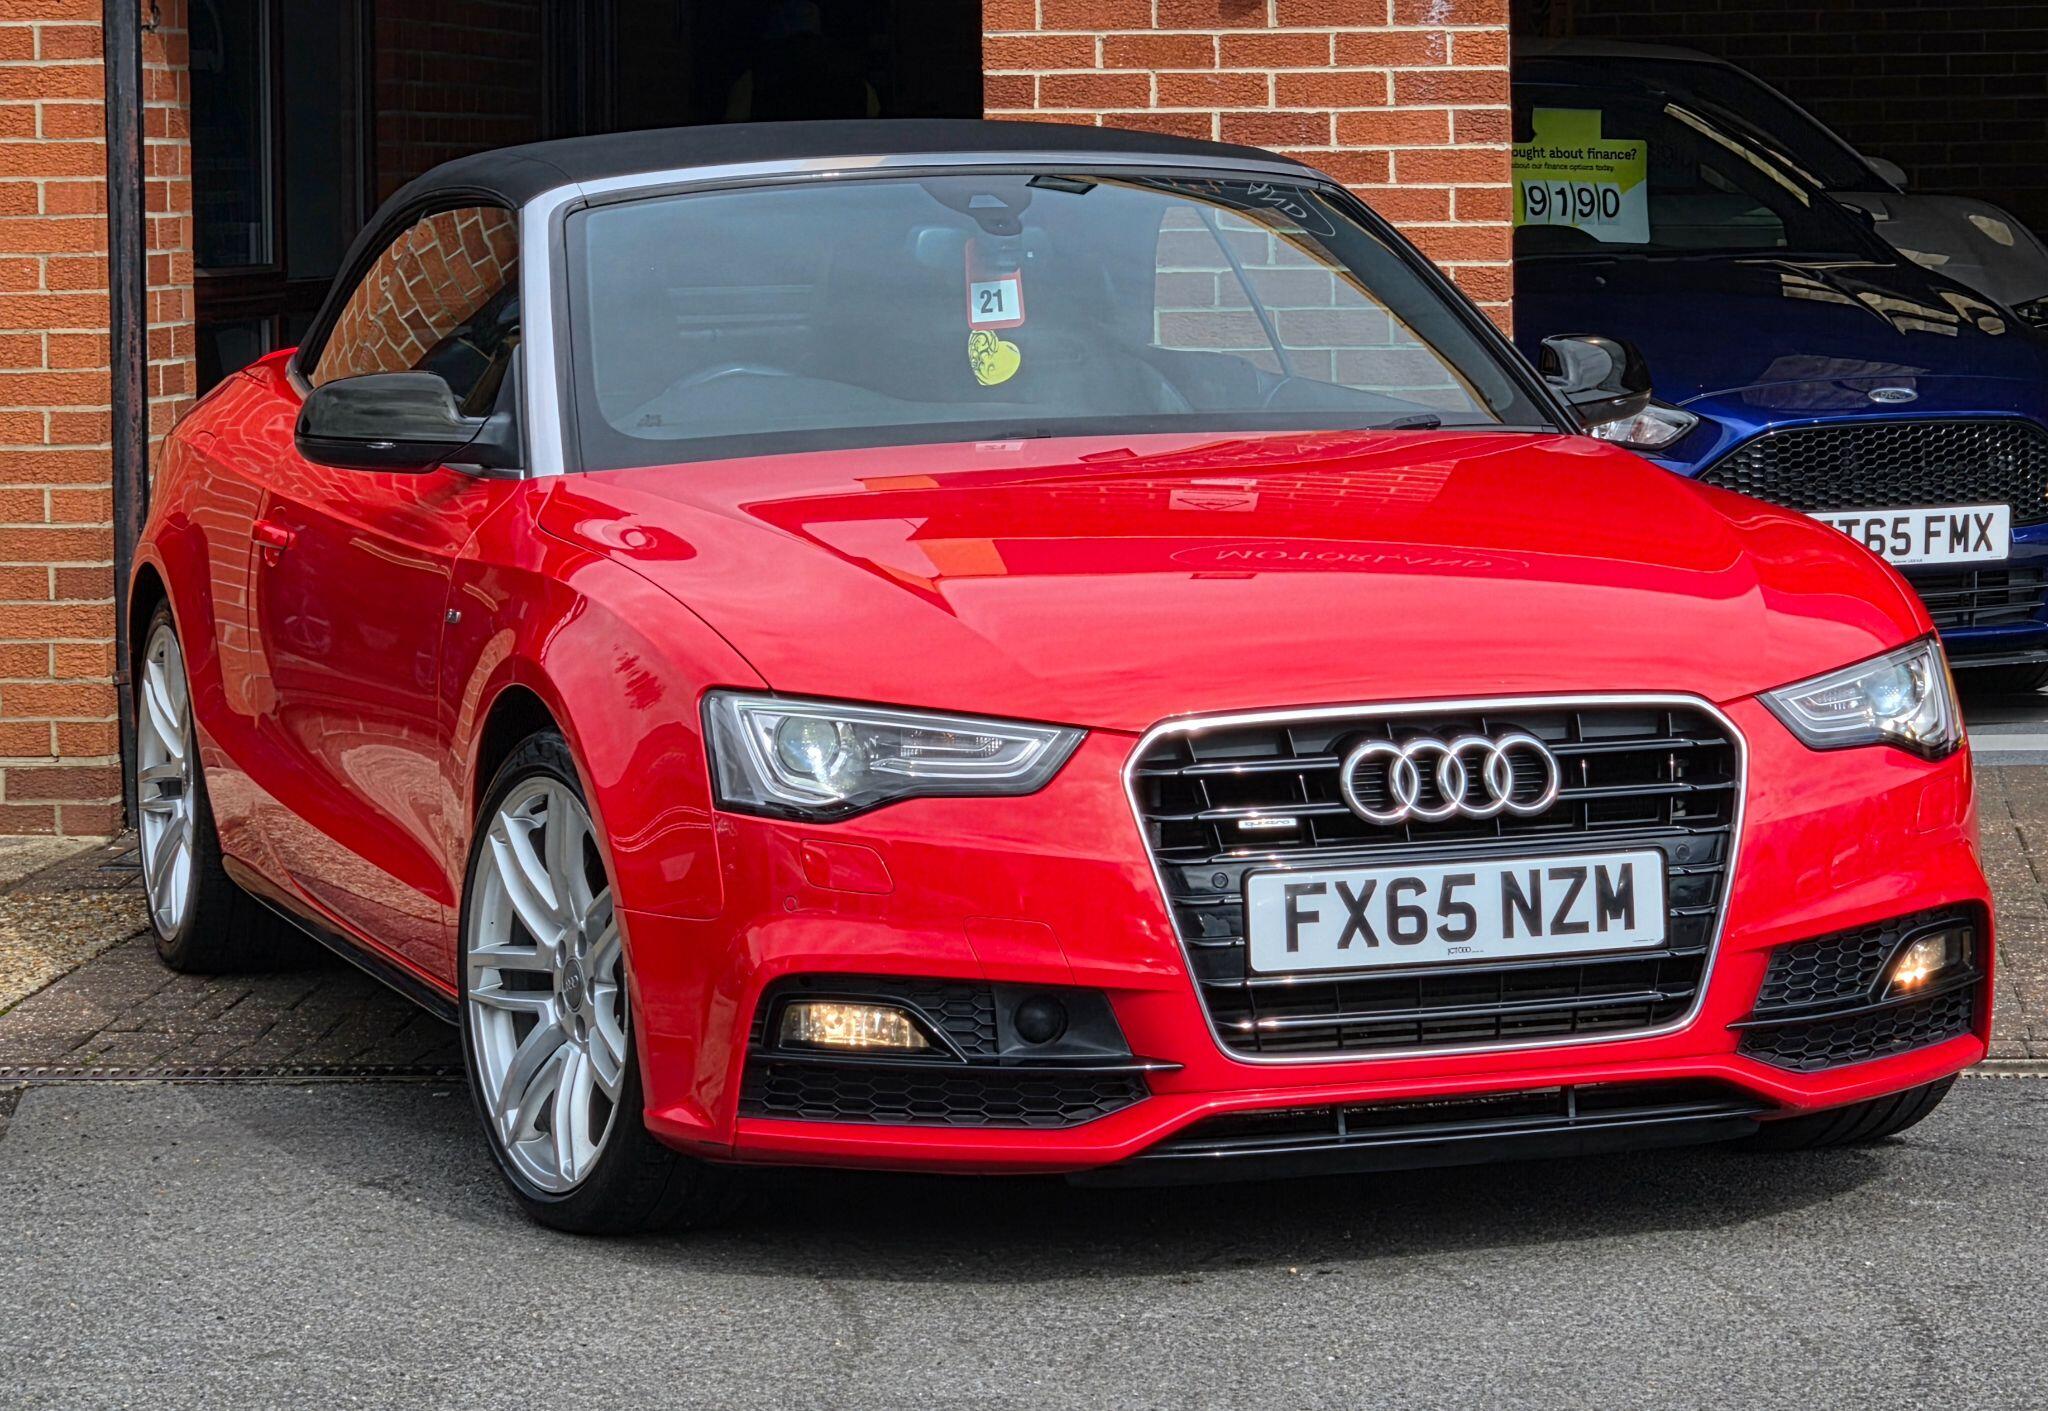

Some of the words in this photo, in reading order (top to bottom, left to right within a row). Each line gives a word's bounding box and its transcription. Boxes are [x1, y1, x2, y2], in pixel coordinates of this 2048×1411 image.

[1512, 147, 1546, 160] ought
[1549, 147, 1583, 159] about
[1587, 147, 1637, 161] finance?
[1544, 162, 1568, 170] finance
[1528, 185, 1620, 219] 9190
[980, 288, 1004, 314] 21
[1820, 517, 1912, 557] T65
[1924, 512, 1995, 555] FMX
[1284, 873, 1478, 953] FX65
[1501, 863, 1636, 939] NZM
